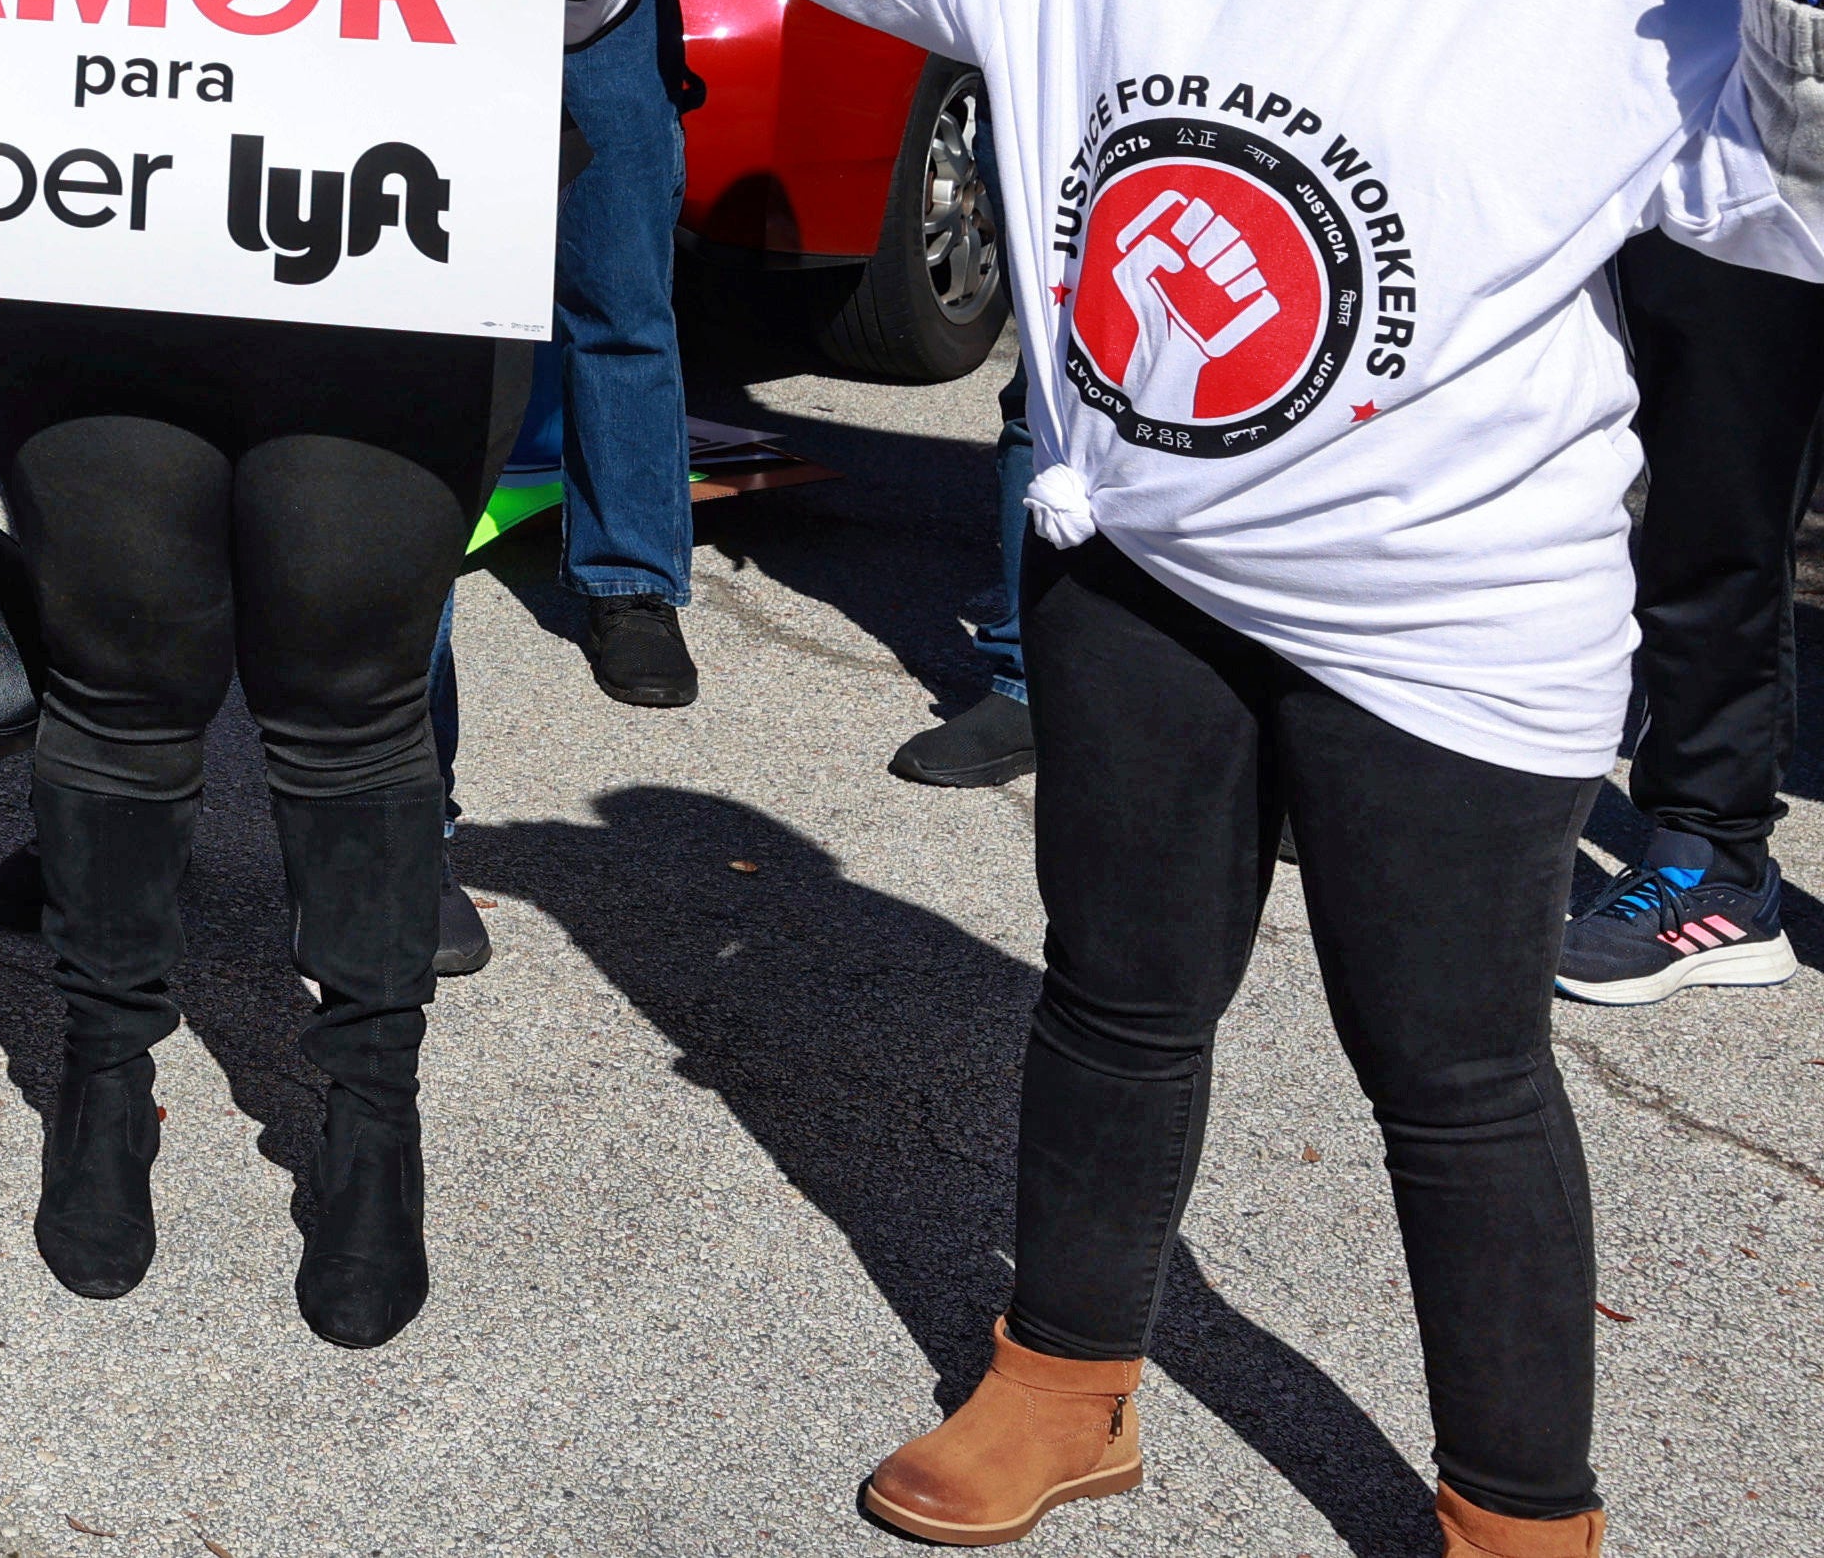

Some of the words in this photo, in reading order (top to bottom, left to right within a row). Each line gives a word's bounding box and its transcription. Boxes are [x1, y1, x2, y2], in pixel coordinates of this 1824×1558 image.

[75, 53, 235, 108] para
[1176, 127, 1218, 148] 公正
[226, 133, 450, 287] lyft
[1053, 93, 1113, 260] JUSTICE
[1116, 74, 1210, 114] FOR
[1219, 82, 1323, 140] APP
[1319, 133, 1417, 380] WORKERS
[1295, 183, 1349, 265] JUSTICIA
[1067, 357, 1126, 413] ADOLAT
[1136, 423, 1193, 449] 정당성
